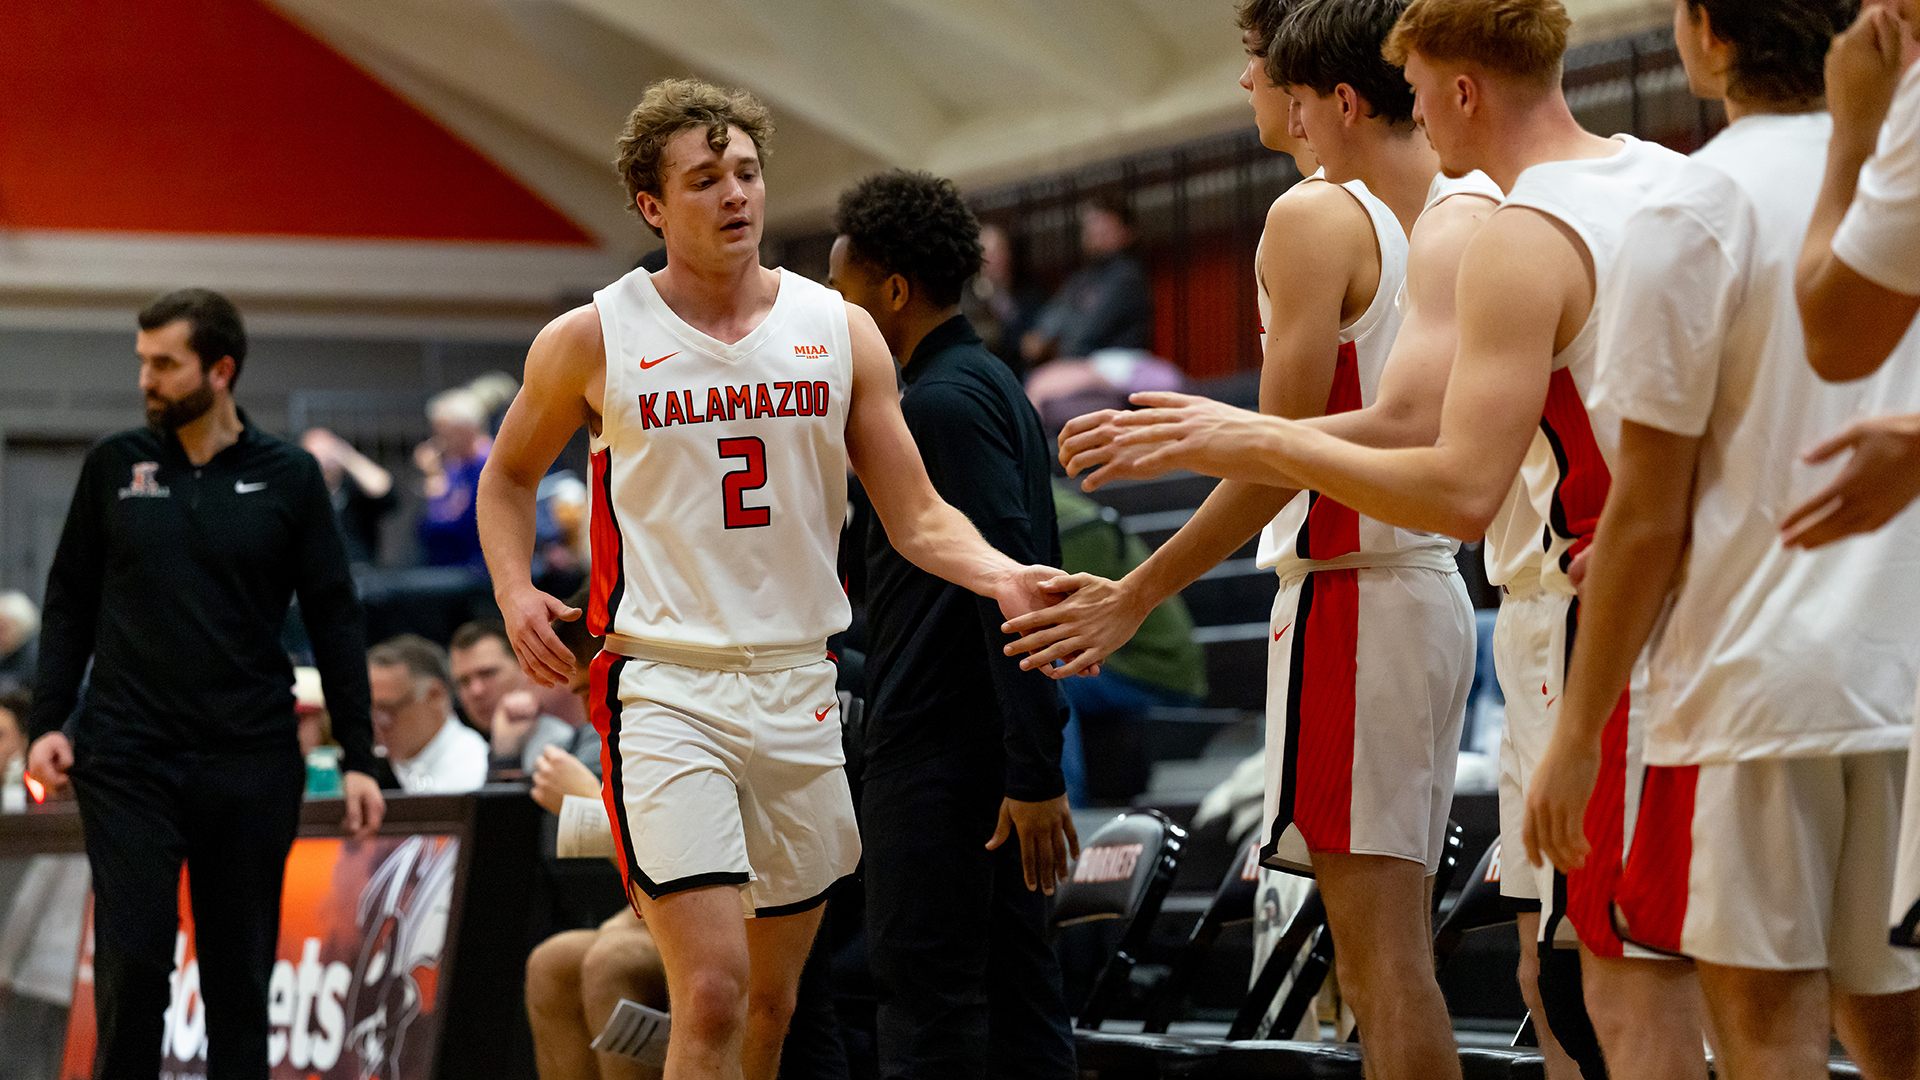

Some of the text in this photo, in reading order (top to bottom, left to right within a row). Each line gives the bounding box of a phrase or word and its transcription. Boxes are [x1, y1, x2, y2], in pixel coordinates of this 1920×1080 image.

[794, 344, 828, 355] MIAA
[638, 381, 830, 430] KALAMAZOO
[717, 436, 771, 530] 2
